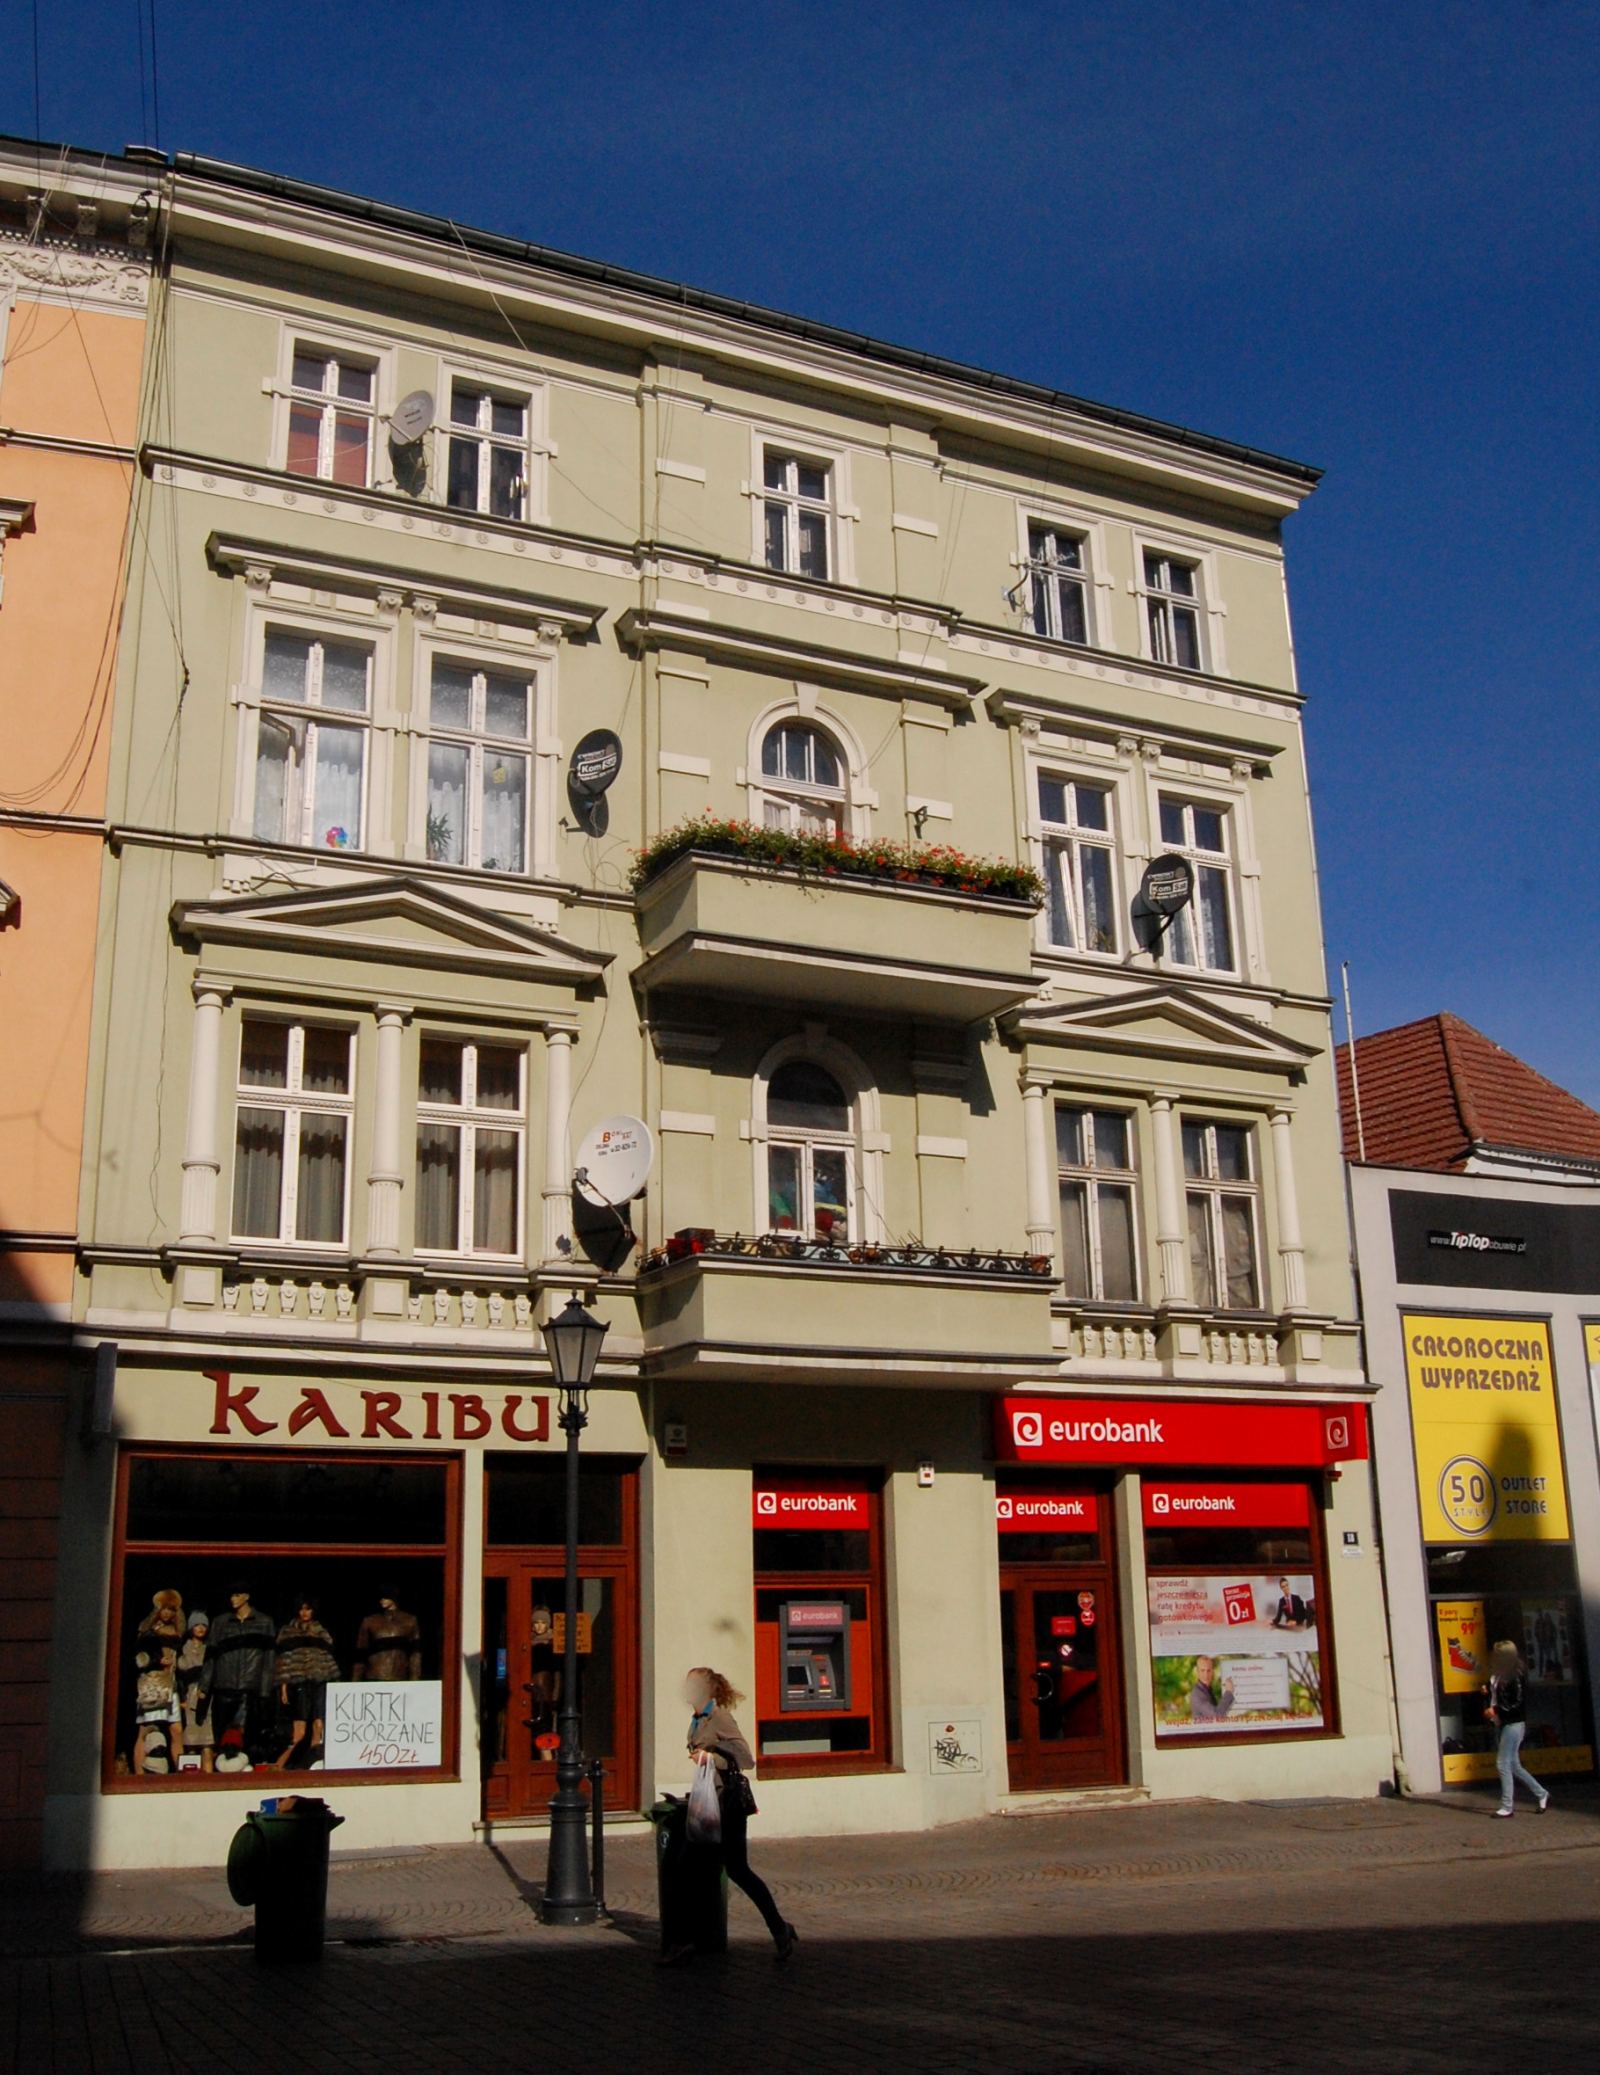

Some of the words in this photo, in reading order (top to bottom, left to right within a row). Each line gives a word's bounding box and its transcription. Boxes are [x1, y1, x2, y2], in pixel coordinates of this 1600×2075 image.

[1412, 1335, 1543, 1361] CAŁOROCZNA
[1421, 1364, 1541, 1392] WYPRZEDAŻ
[202, 1370, 549, 1442] KARIBU
[1050, 1417, 1164, 1443] eurobank
[1451, 1475, 1485, 1503] 50
[1501, 1476, 1547, 1491] OUTLET
[781, 1495, 857, 1511] eurobank
[1016, 1500, 1084, 1516] eurobank
[1172, 1496, 1236, 1511] eurobank
[1506, 1499, 1547, 1514] STORE
[335, 1692, 406, 1722] KURTKI
[334, 1719, 434, 1744] SKÓRZANE
